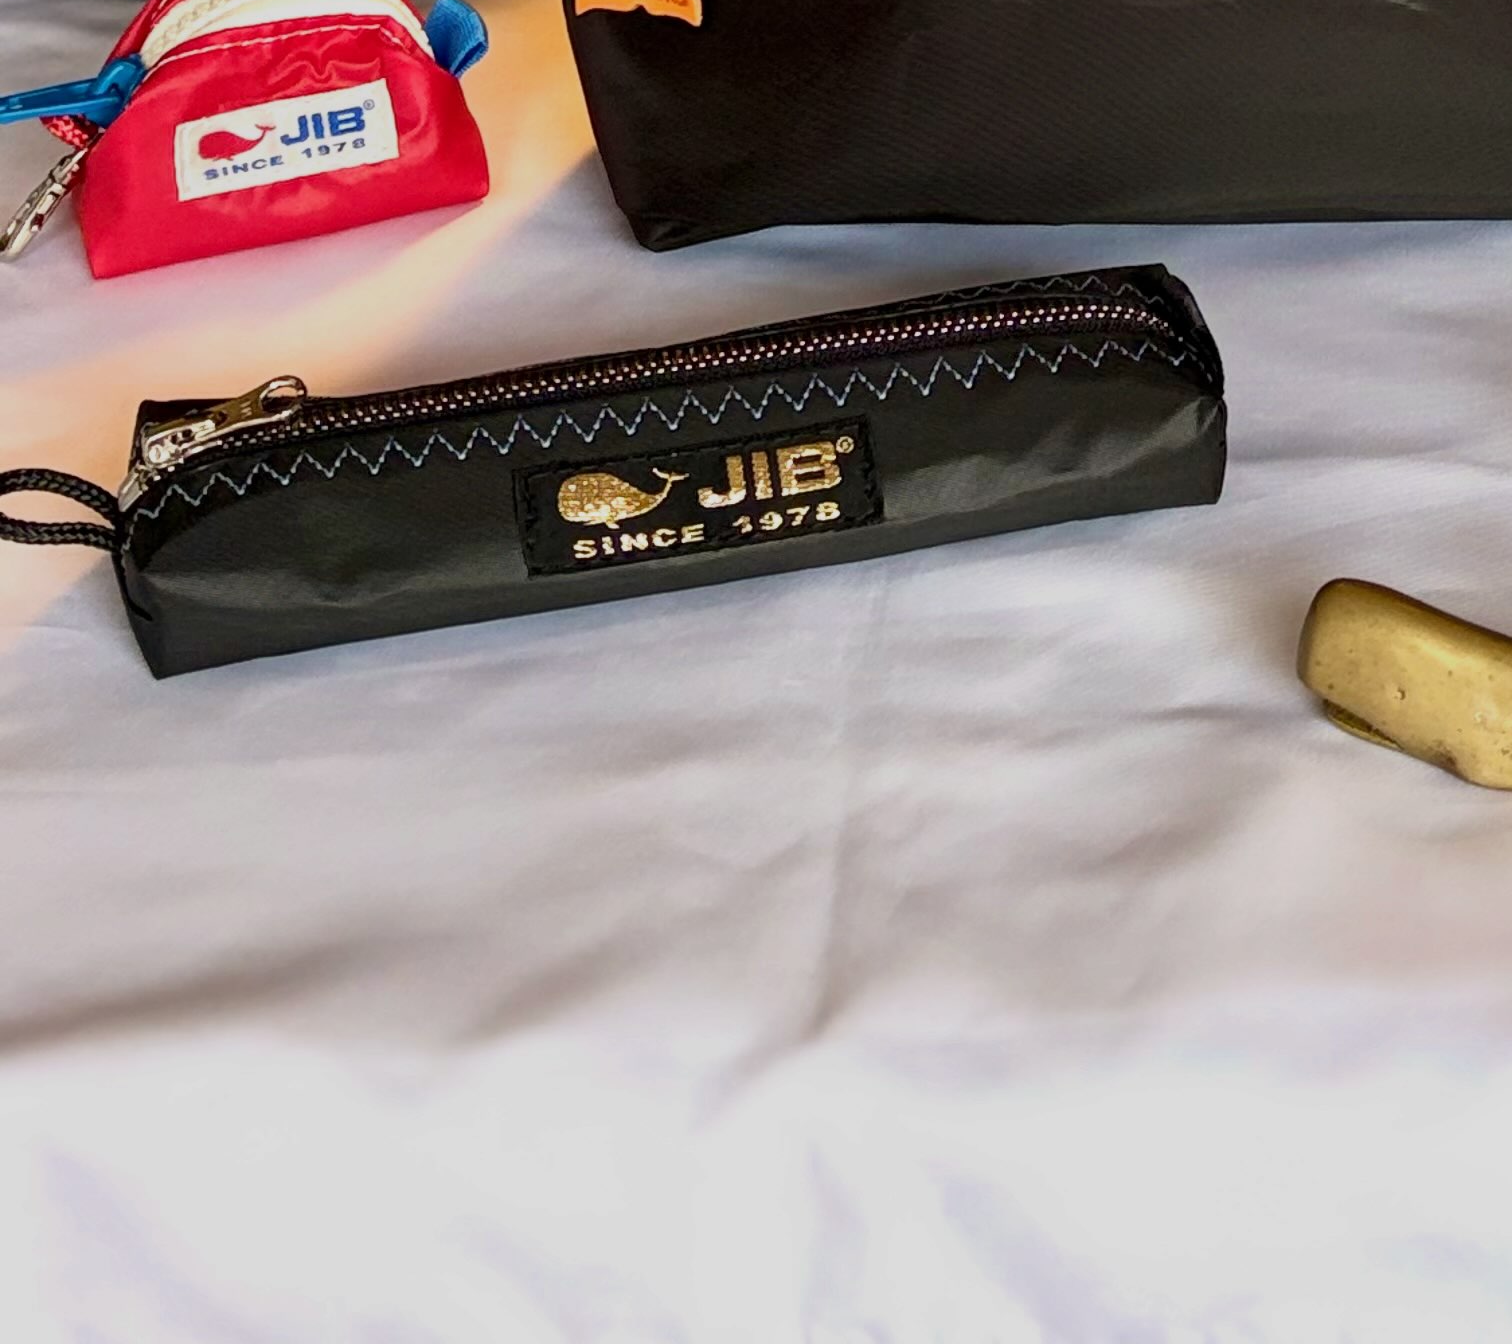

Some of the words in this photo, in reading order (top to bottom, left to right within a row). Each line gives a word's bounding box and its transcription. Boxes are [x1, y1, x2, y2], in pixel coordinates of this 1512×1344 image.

[280, 106, 366, 146] JIB
[203, 155, 284, 180] SINCE
[301, 138, 366, 159] 1978
[697, 440, 842, 509] JIB
[573, 523, 705, 559] SINCE
[733, 501, 841, 534] 1978
